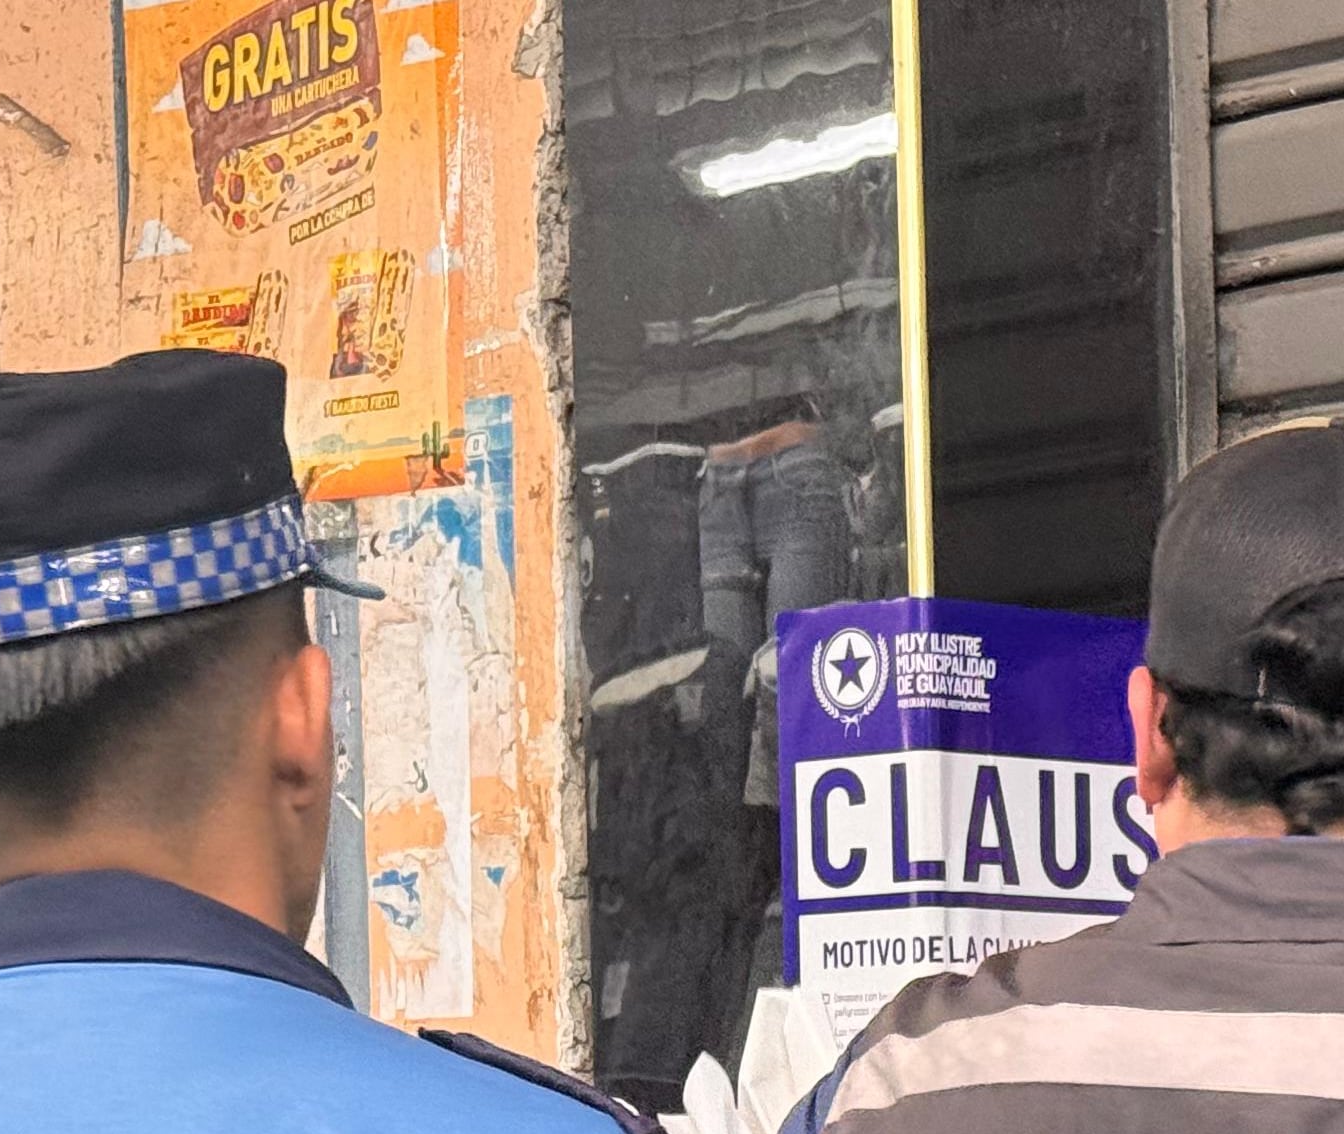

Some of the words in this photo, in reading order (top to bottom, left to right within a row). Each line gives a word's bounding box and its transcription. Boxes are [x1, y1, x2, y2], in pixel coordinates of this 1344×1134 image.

[203, 0, 358, 112] GRATIS
[271, 93, 294, 117] UNA
[294, 66, 360, 110] CARTUCHERA
[290, 220, 310, 240] POR
[896, 632, 928, 655] MUY
[930, 632, 983, 657] ILUSTRE
[896, 653, 996, 680] MUNICIPALIDAD
[896, 674, 914, 696] DE
[916, 673, 991, 700] GUAYAQUIL
[823, 937, 906, 970] MOTIVO
[913, 935, 944, 964] DE
[949, 935, 978, 965] LA
